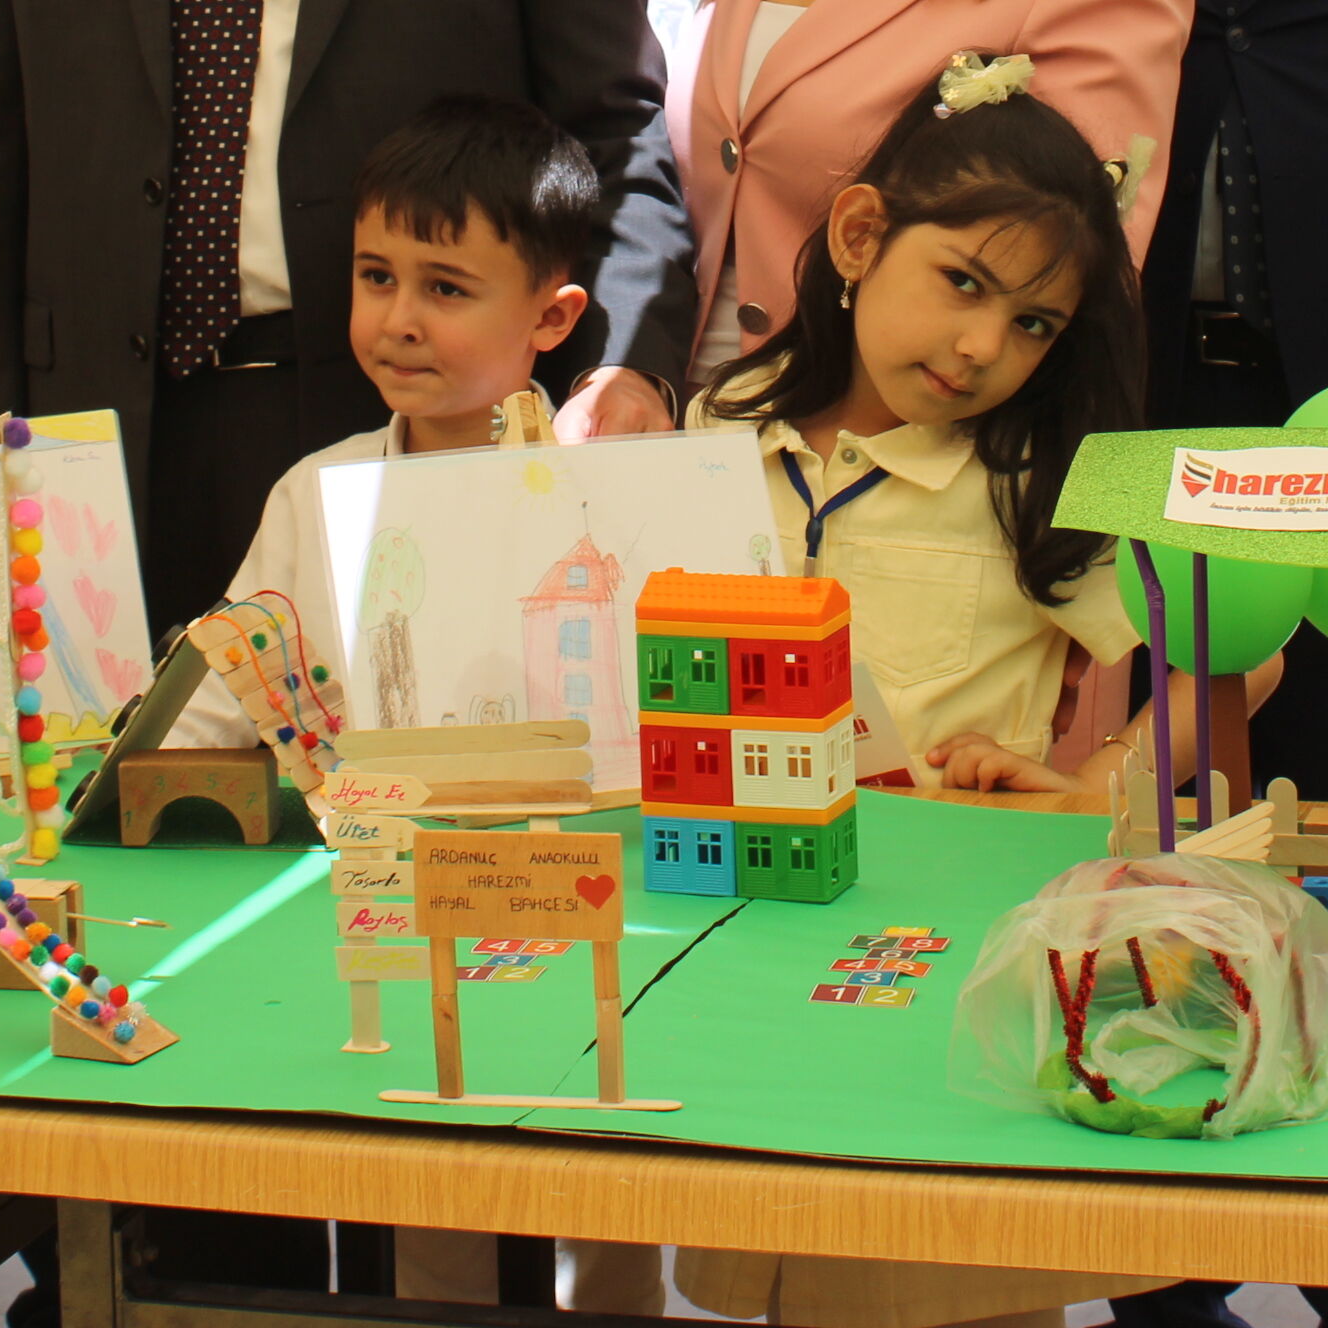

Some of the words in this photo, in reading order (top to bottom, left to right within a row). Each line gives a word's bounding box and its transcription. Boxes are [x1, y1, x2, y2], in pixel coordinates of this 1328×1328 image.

[1280, 496, 1321, 505] Eğitim
[429, 848, 497, 866] ARDANUÇ
[529, 851, 600, 865] ANAOKULU
[430, 895, 476, 911] HAYAL
[487, 940, 510, 952] 4
[533, 942, 559, 952] 5
[912, 939, 933, 948] 8
[497, 955, 520, 965] 3
[881, 950, 903, 959] 6
[844, 960, 866, 969] 4
[894, 961, 915, 971] 5
[465, 967, 480, 978] 1
[503, 967, 530, 978] 2
[860, 972, 882, 983] 3
[831, 987, 847, 1000] 1
[874, 989, 899, 1003] 2
